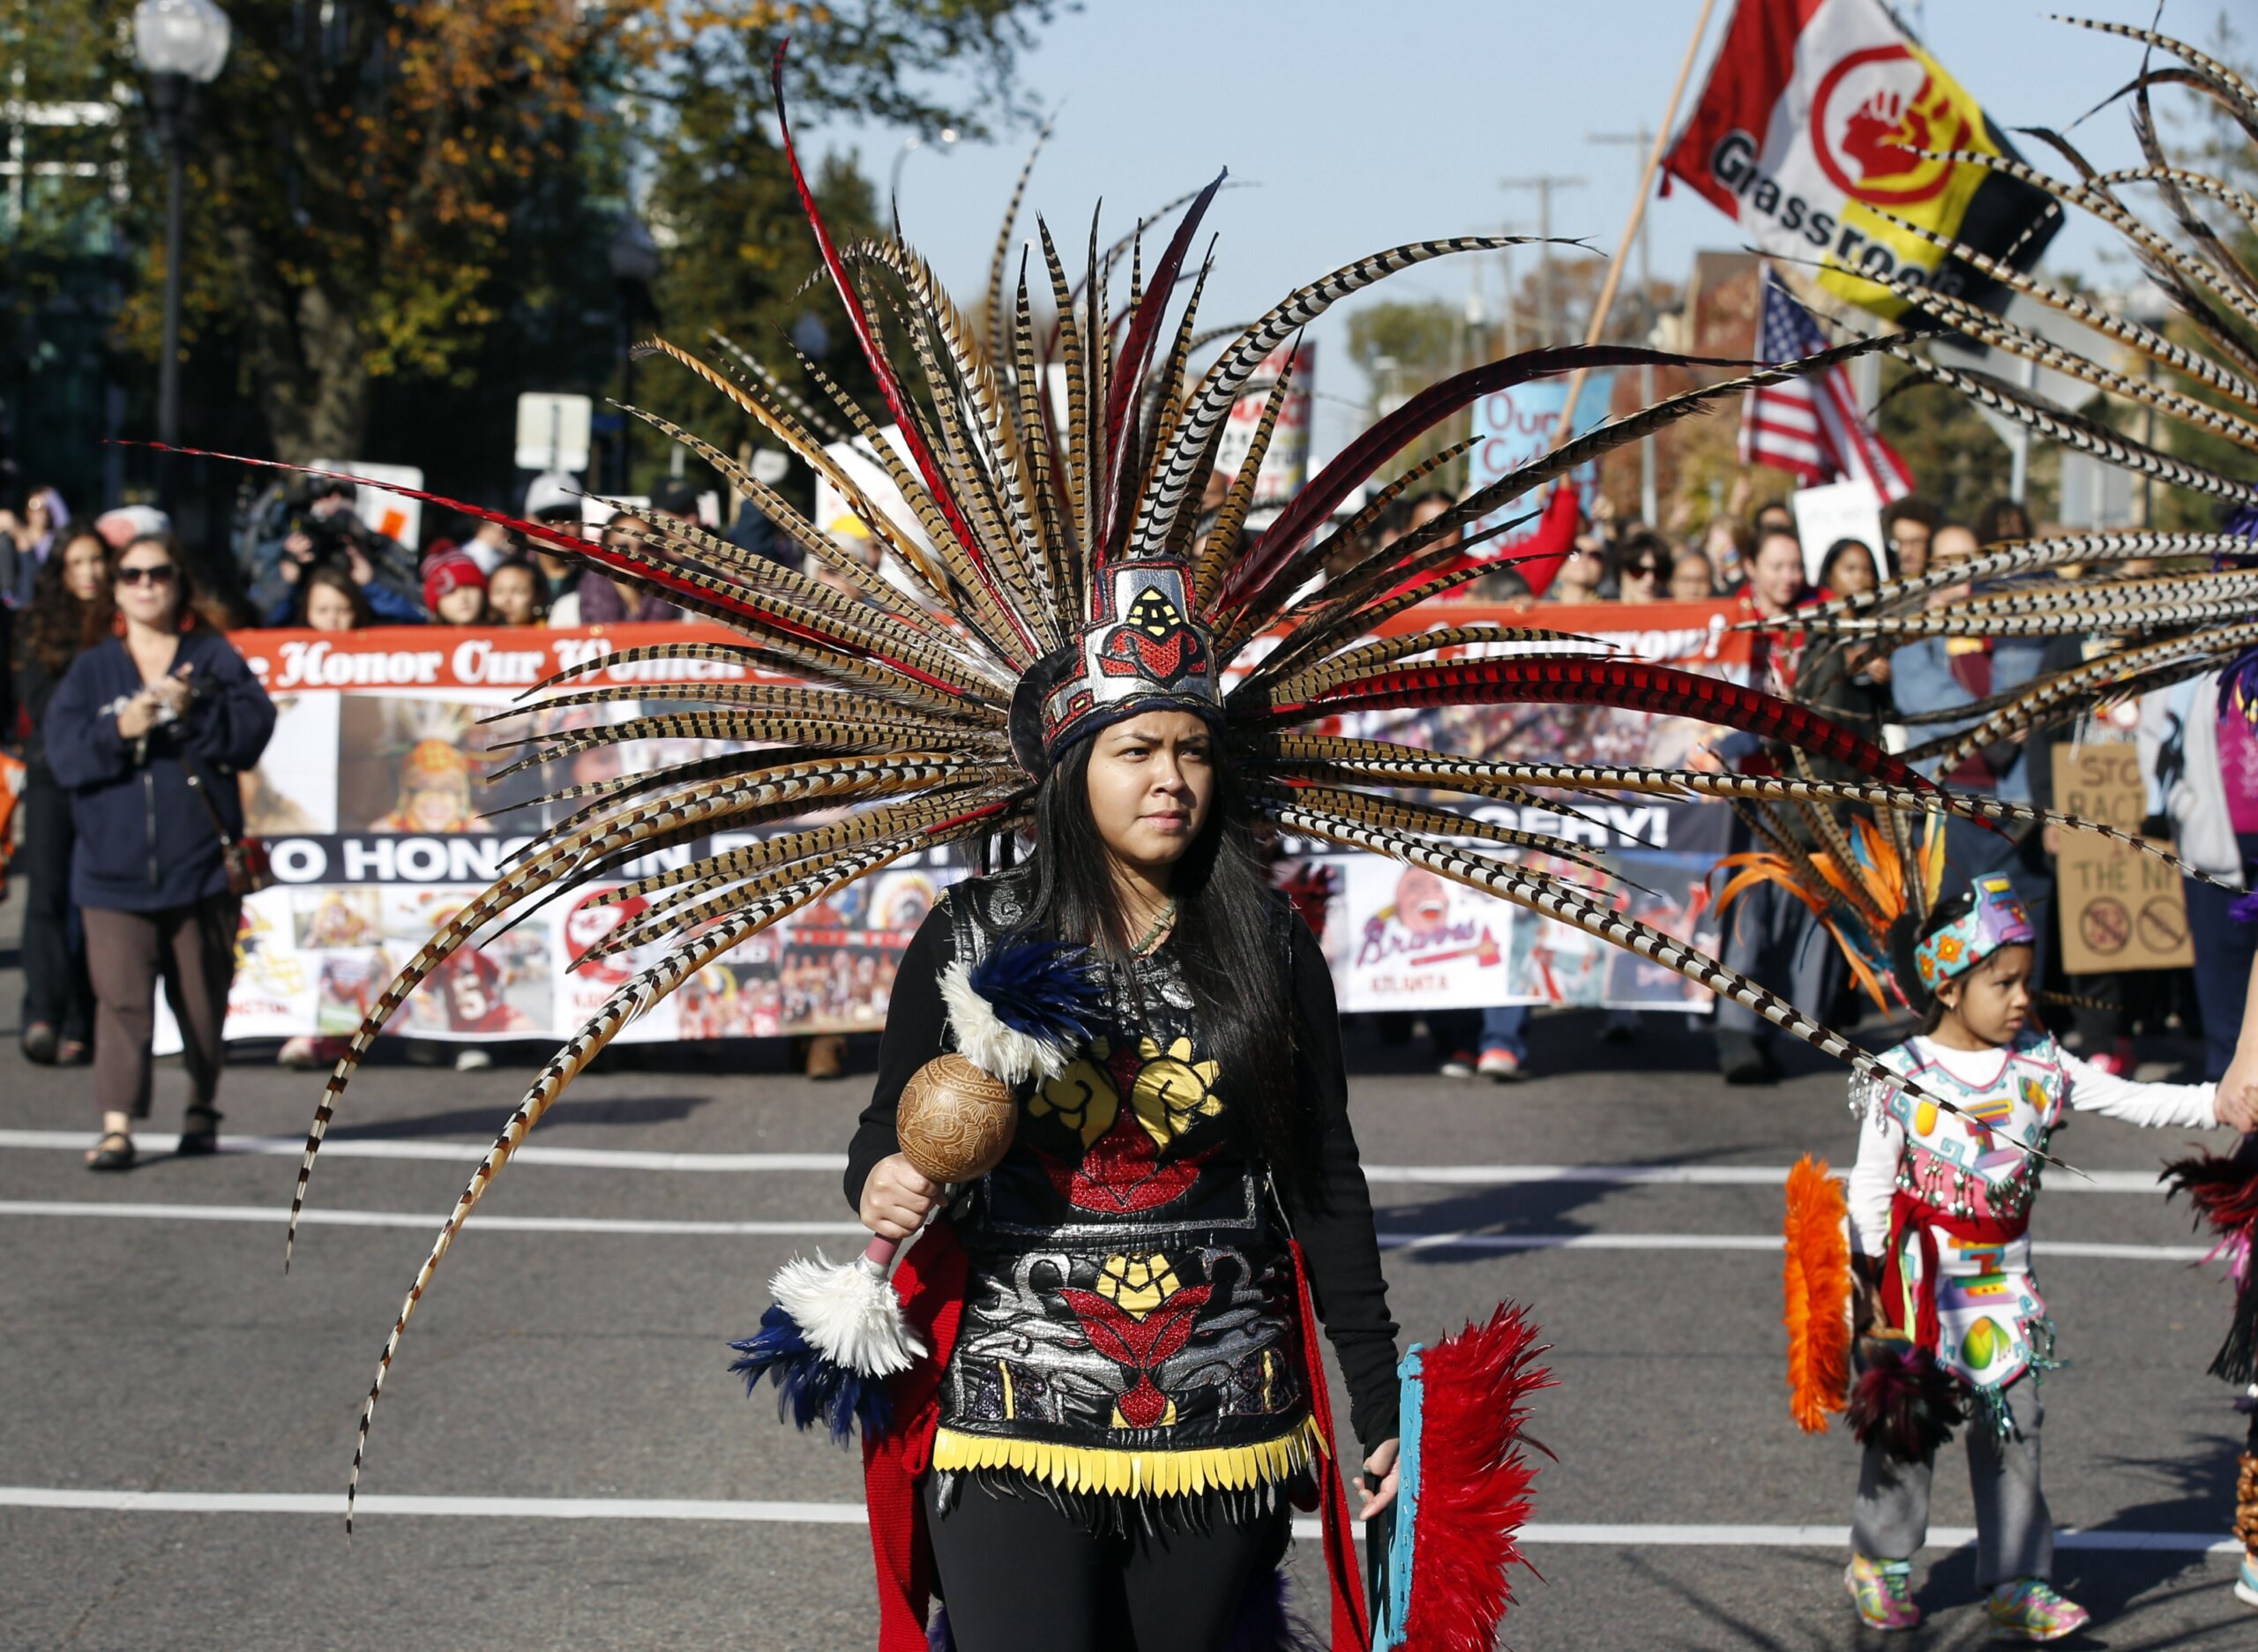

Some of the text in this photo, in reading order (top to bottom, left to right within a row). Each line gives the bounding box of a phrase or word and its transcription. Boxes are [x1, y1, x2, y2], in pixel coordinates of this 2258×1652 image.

[1486, 391, 1560, 436] Our
[275, 640, 444, 687] Honor
[452, 639, 545, 684] Our
[263, 837, 328, 883] O
[343, 836, 602, 880] HONO
[2073, 858, 2128, 893] THE
